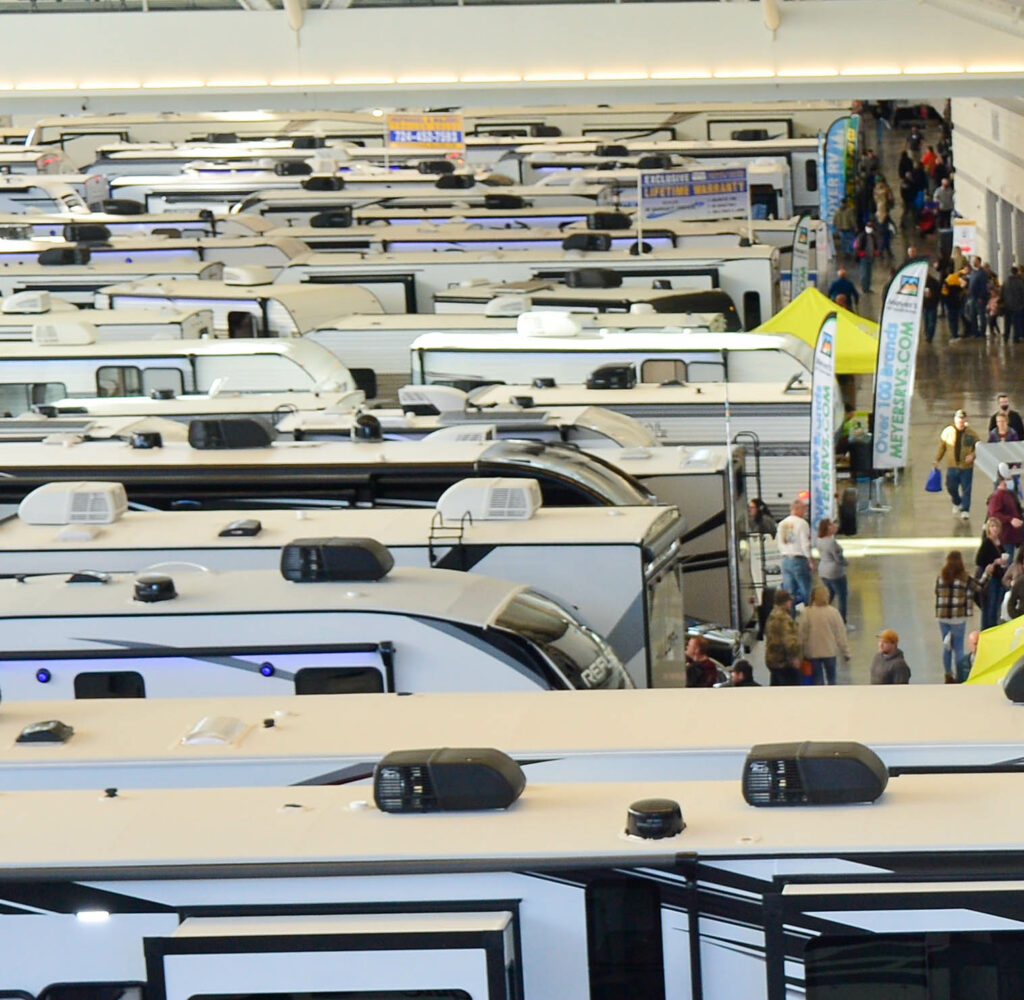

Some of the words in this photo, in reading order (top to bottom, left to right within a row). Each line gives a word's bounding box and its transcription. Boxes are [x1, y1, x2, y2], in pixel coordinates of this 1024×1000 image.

[880, 322, 899, 377] Brands
[878, 381, 893, 408] 100
[889, 321, 914, 459] MEYERSRVS.COM
[875, 415, 889, 454] Over
